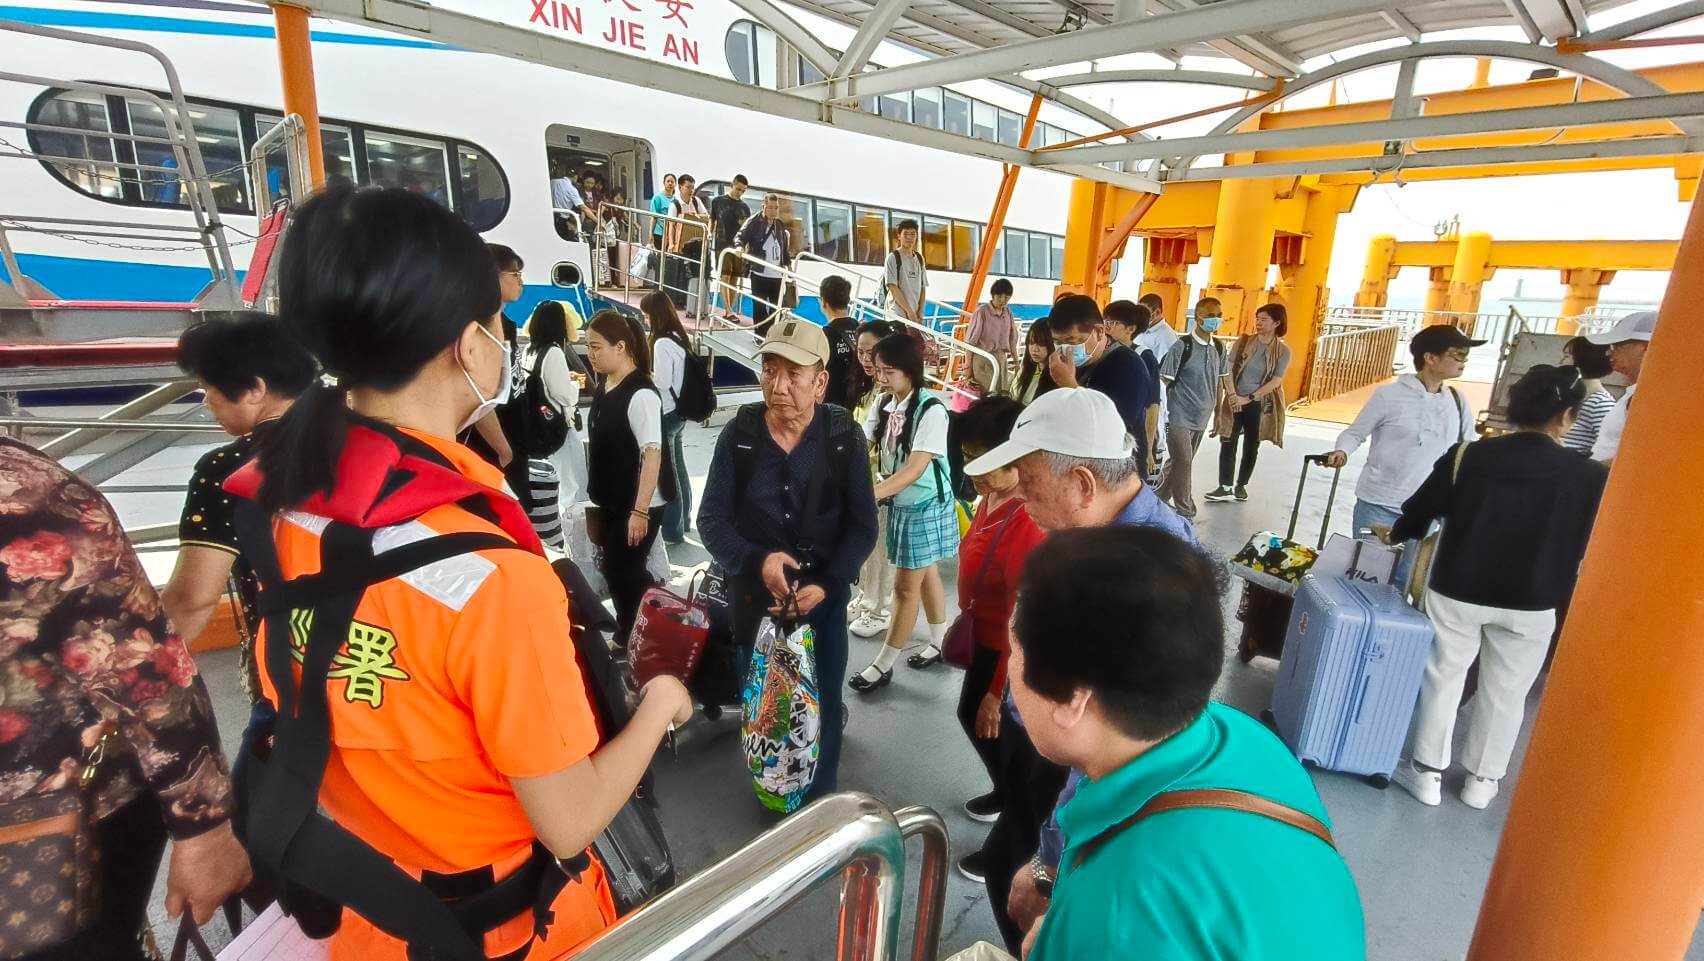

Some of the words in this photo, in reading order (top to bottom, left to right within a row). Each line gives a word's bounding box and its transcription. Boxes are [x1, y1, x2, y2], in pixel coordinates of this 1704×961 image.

[529, 0, 583, 34] XIN
[603, 17, 646, 51] JIE
[663, 33, 699, 65] AN
[1345, 567, 1379, 585] FILA
